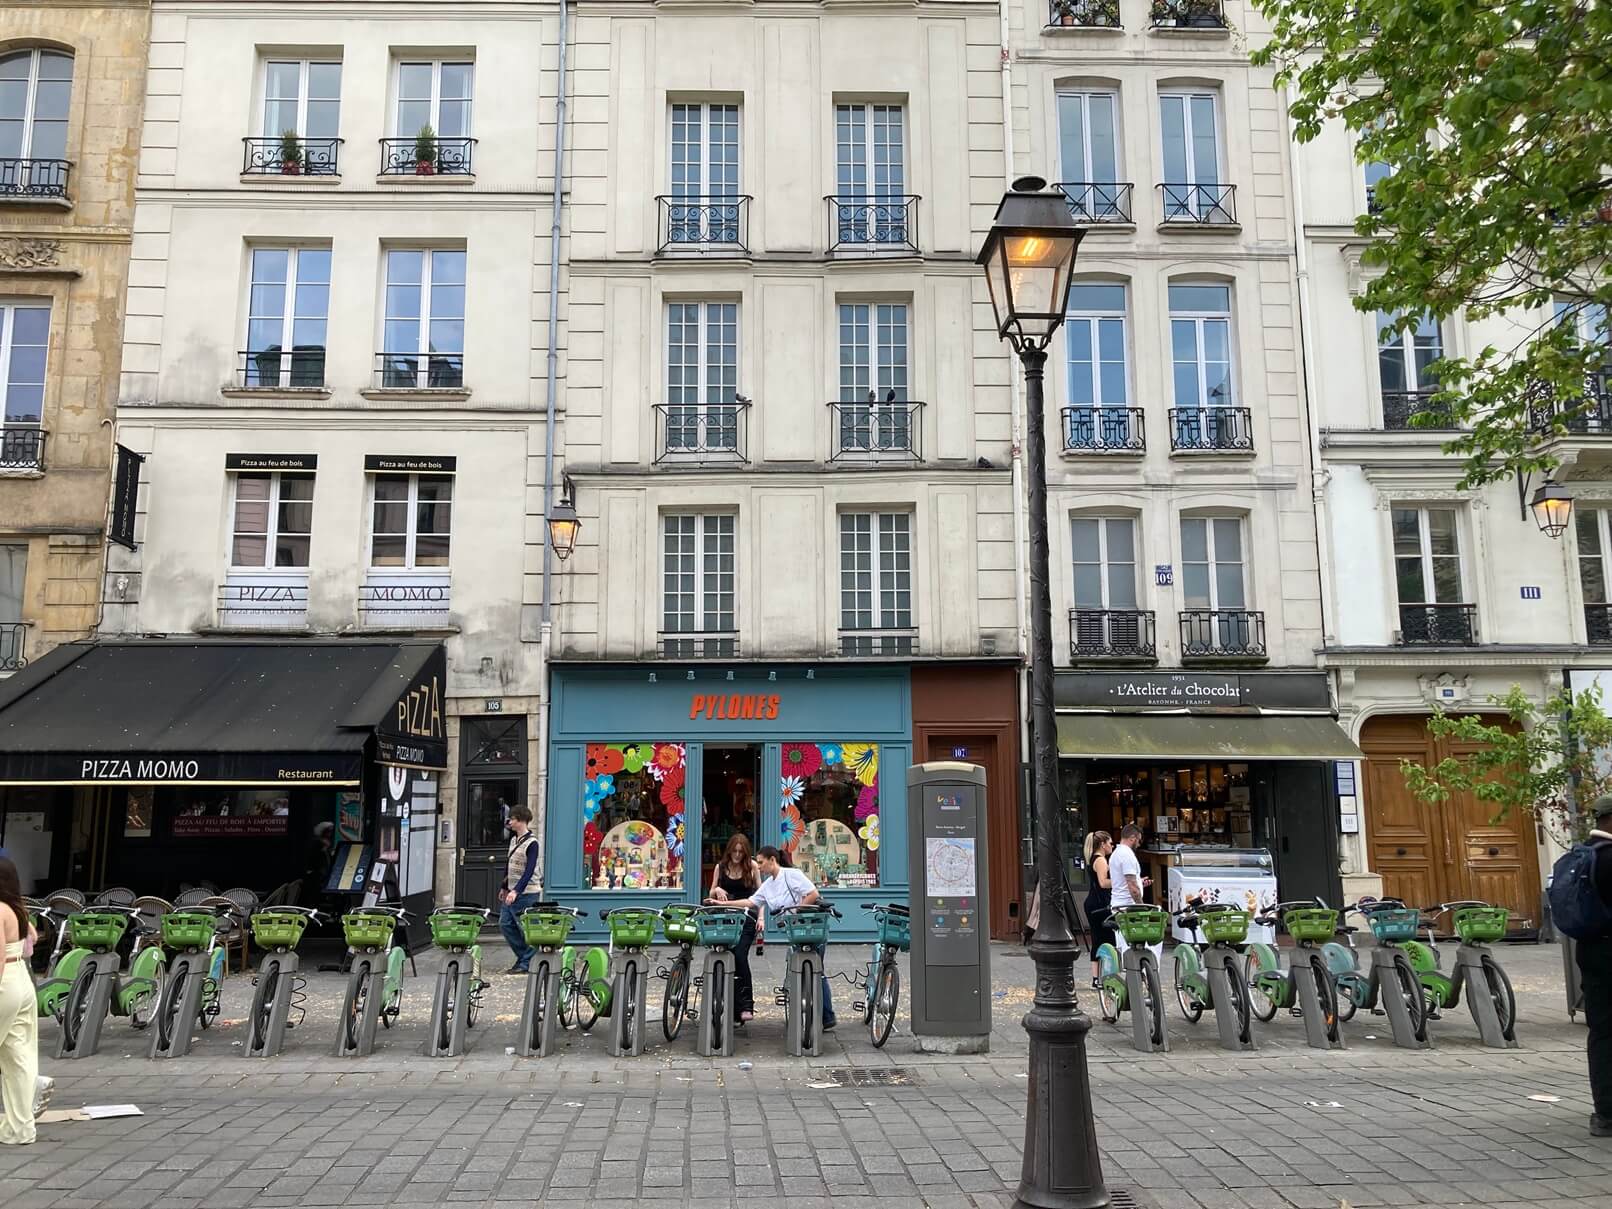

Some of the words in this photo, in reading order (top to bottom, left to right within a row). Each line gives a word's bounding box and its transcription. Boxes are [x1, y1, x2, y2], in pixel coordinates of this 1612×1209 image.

[1155, 573, 1172, 584] 109
[239, 586, 296, 601] PIZZA
[372, 586, 444, 601] MOMO
[1524, 588, 1538, 598] 111
[1117, 682, 1168, 696] L'Atelier
[1171, 686, 1182, 696] du
[1185, 682, 1240, 696] Chocolat
[398, 676, 442, 738] PIZZA
[488, 701, 500, 710] 105
[689, 694, 779, 720] PYLONES
[954, 748, 966, 758] 107
[82, 760, 132, 778] PIZZA
[137, 760, 199, 778] MOMO
[278, 769, 334, 778] Restaurant
